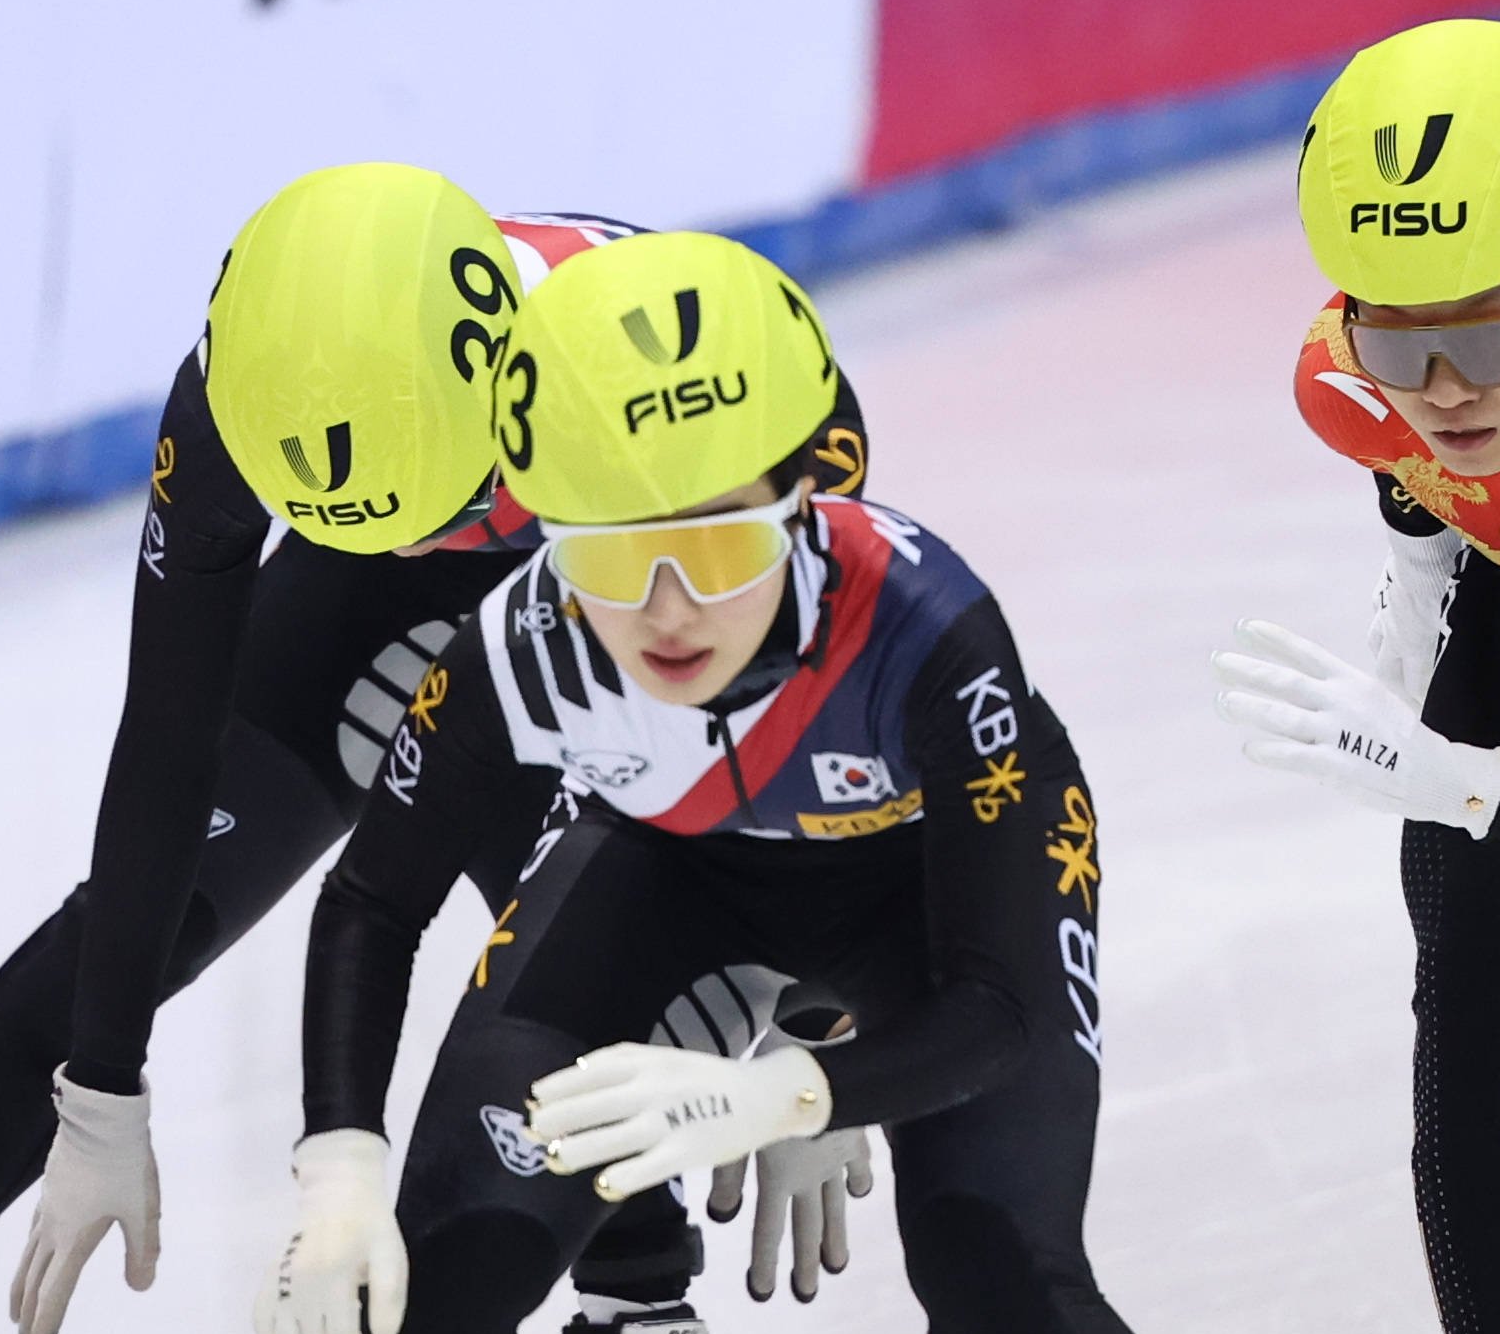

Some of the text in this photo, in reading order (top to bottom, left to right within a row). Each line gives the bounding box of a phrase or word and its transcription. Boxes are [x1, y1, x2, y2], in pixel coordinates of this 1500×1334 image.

[1350, 200, 1468, 237] FISU
[450, 247, 519, 385] 39
[497, 347, 538, 472] 3
[625, 370, 749, 435] FISU
[286, 491, 401, 527] FISU
[513, 601, 557, 637] KB
[956, 665, 1019, 757] KB
[383, 722, 423, 806] KB
[1337, 728, 1401, 773] NALZA
[663, 1092, 735, 1131] NALZA
